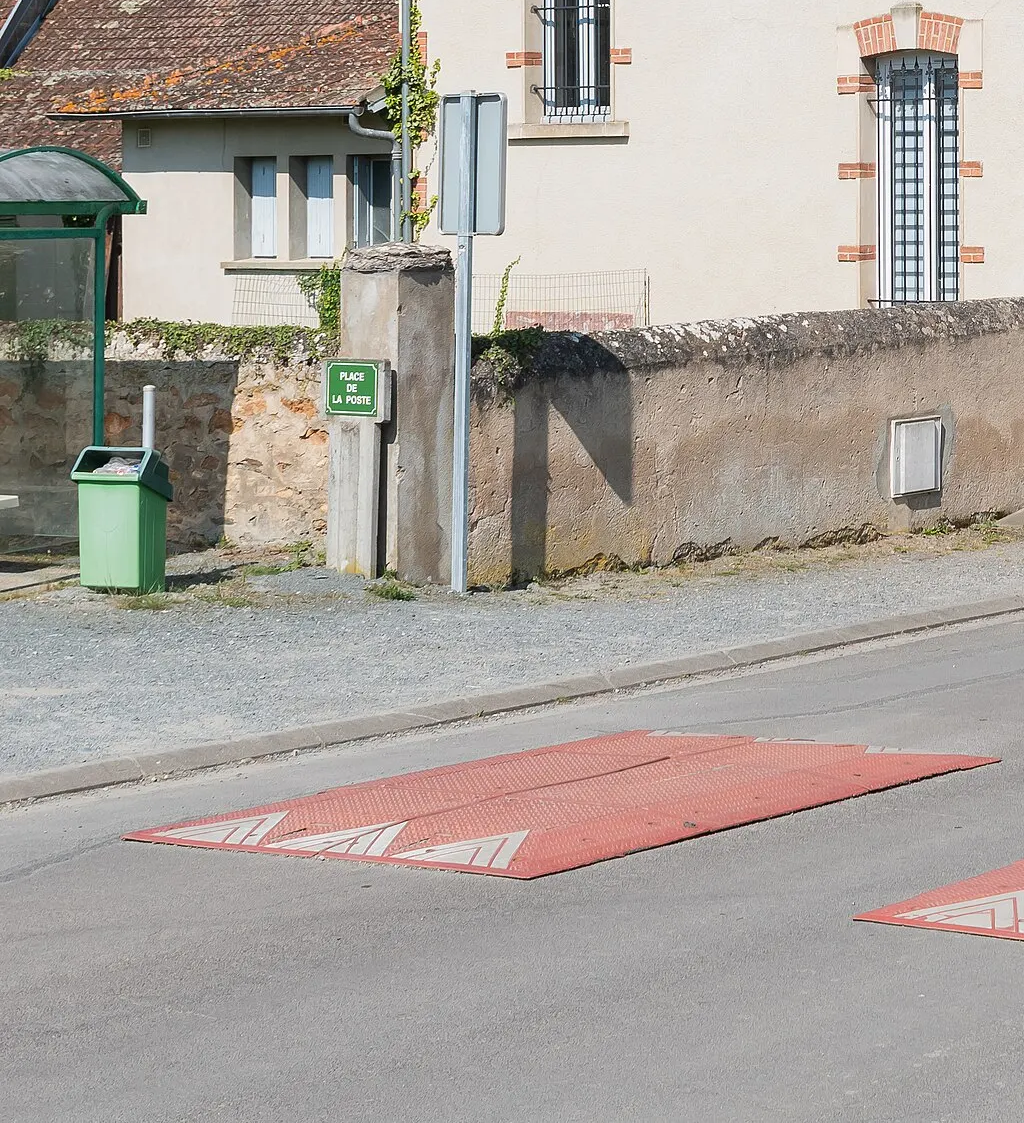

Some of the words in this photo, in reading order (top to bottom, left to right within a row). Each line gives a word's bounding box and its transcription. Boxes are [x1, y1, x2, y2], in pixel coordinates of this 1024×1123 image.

[339, 371, 365, 381] PLACE
[346, 383, 358, 393] DE
[332, 394, 343, 404] LA
[345, 395, 372, 405] POSTE
